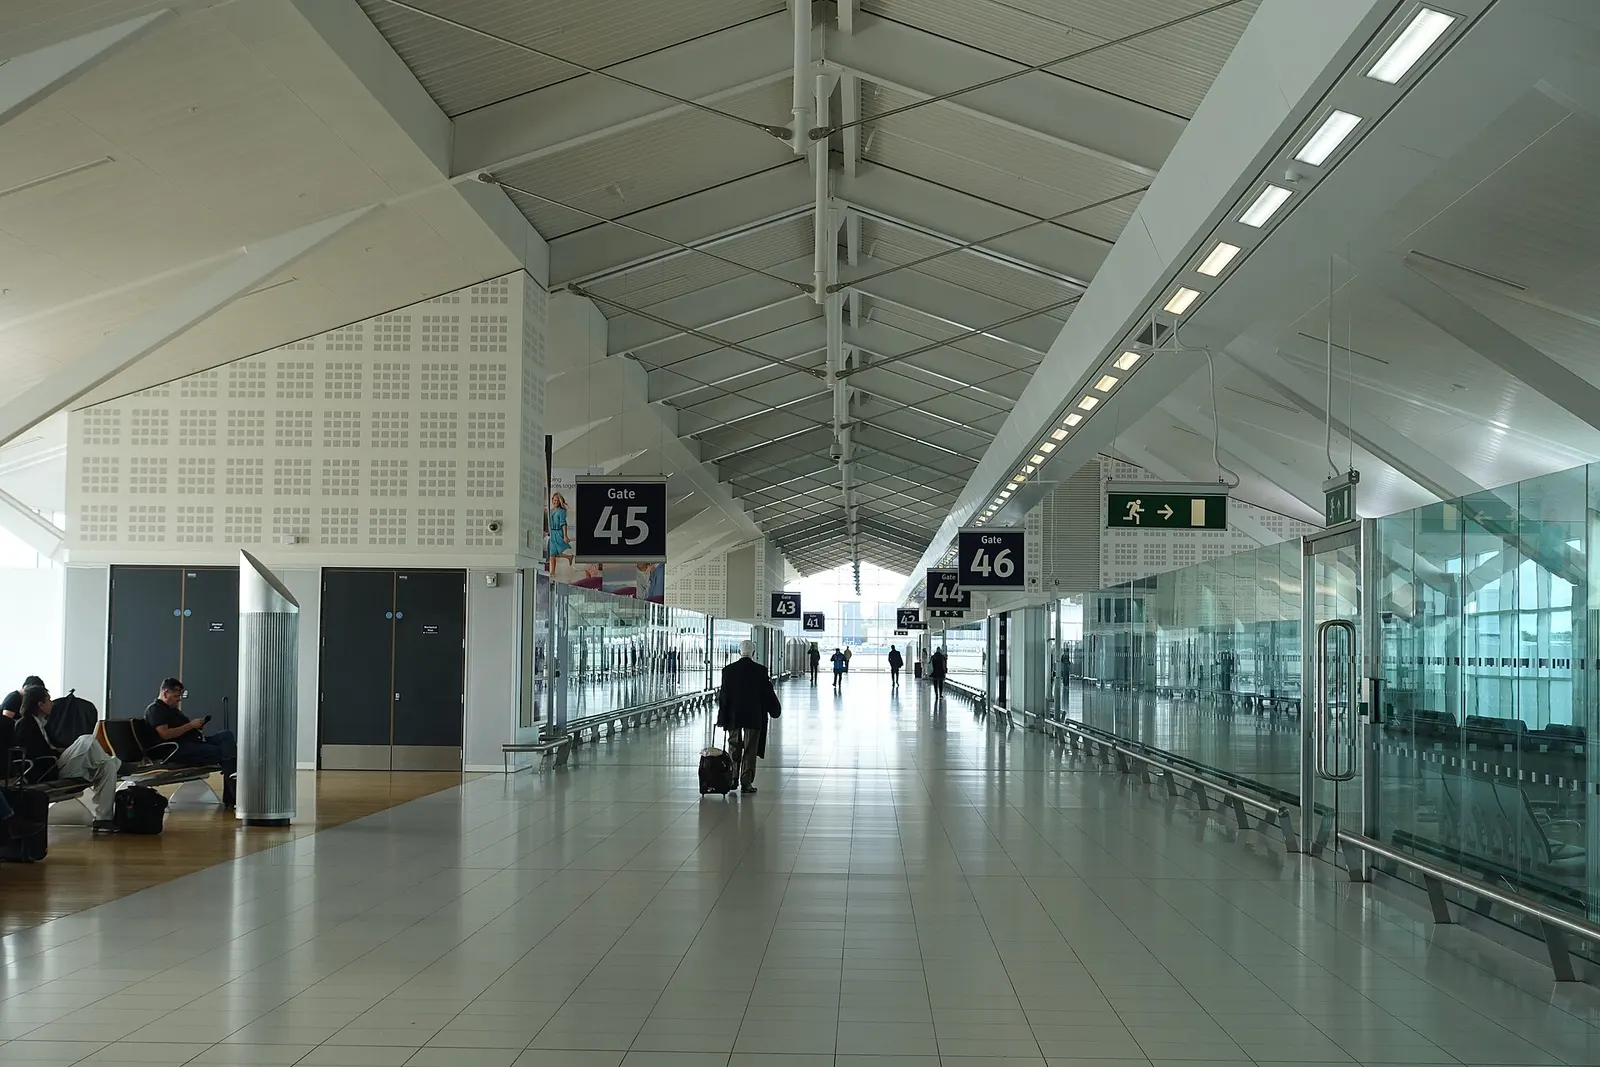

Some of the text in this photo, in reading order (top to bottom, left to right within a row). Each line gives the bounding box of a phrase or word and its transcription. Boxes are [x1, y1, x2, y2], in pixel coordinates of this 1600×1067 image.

[607, 488, 636, 499] Gate
[593, 506, 650, 545] 45
[981, 535, 1002, 544] Gate
[970, 548, 1015, 578] 46
[934, 583, 964, 602] 44
[776, 600, 796, 615] 43
[806, 618, 819, 628] 41
